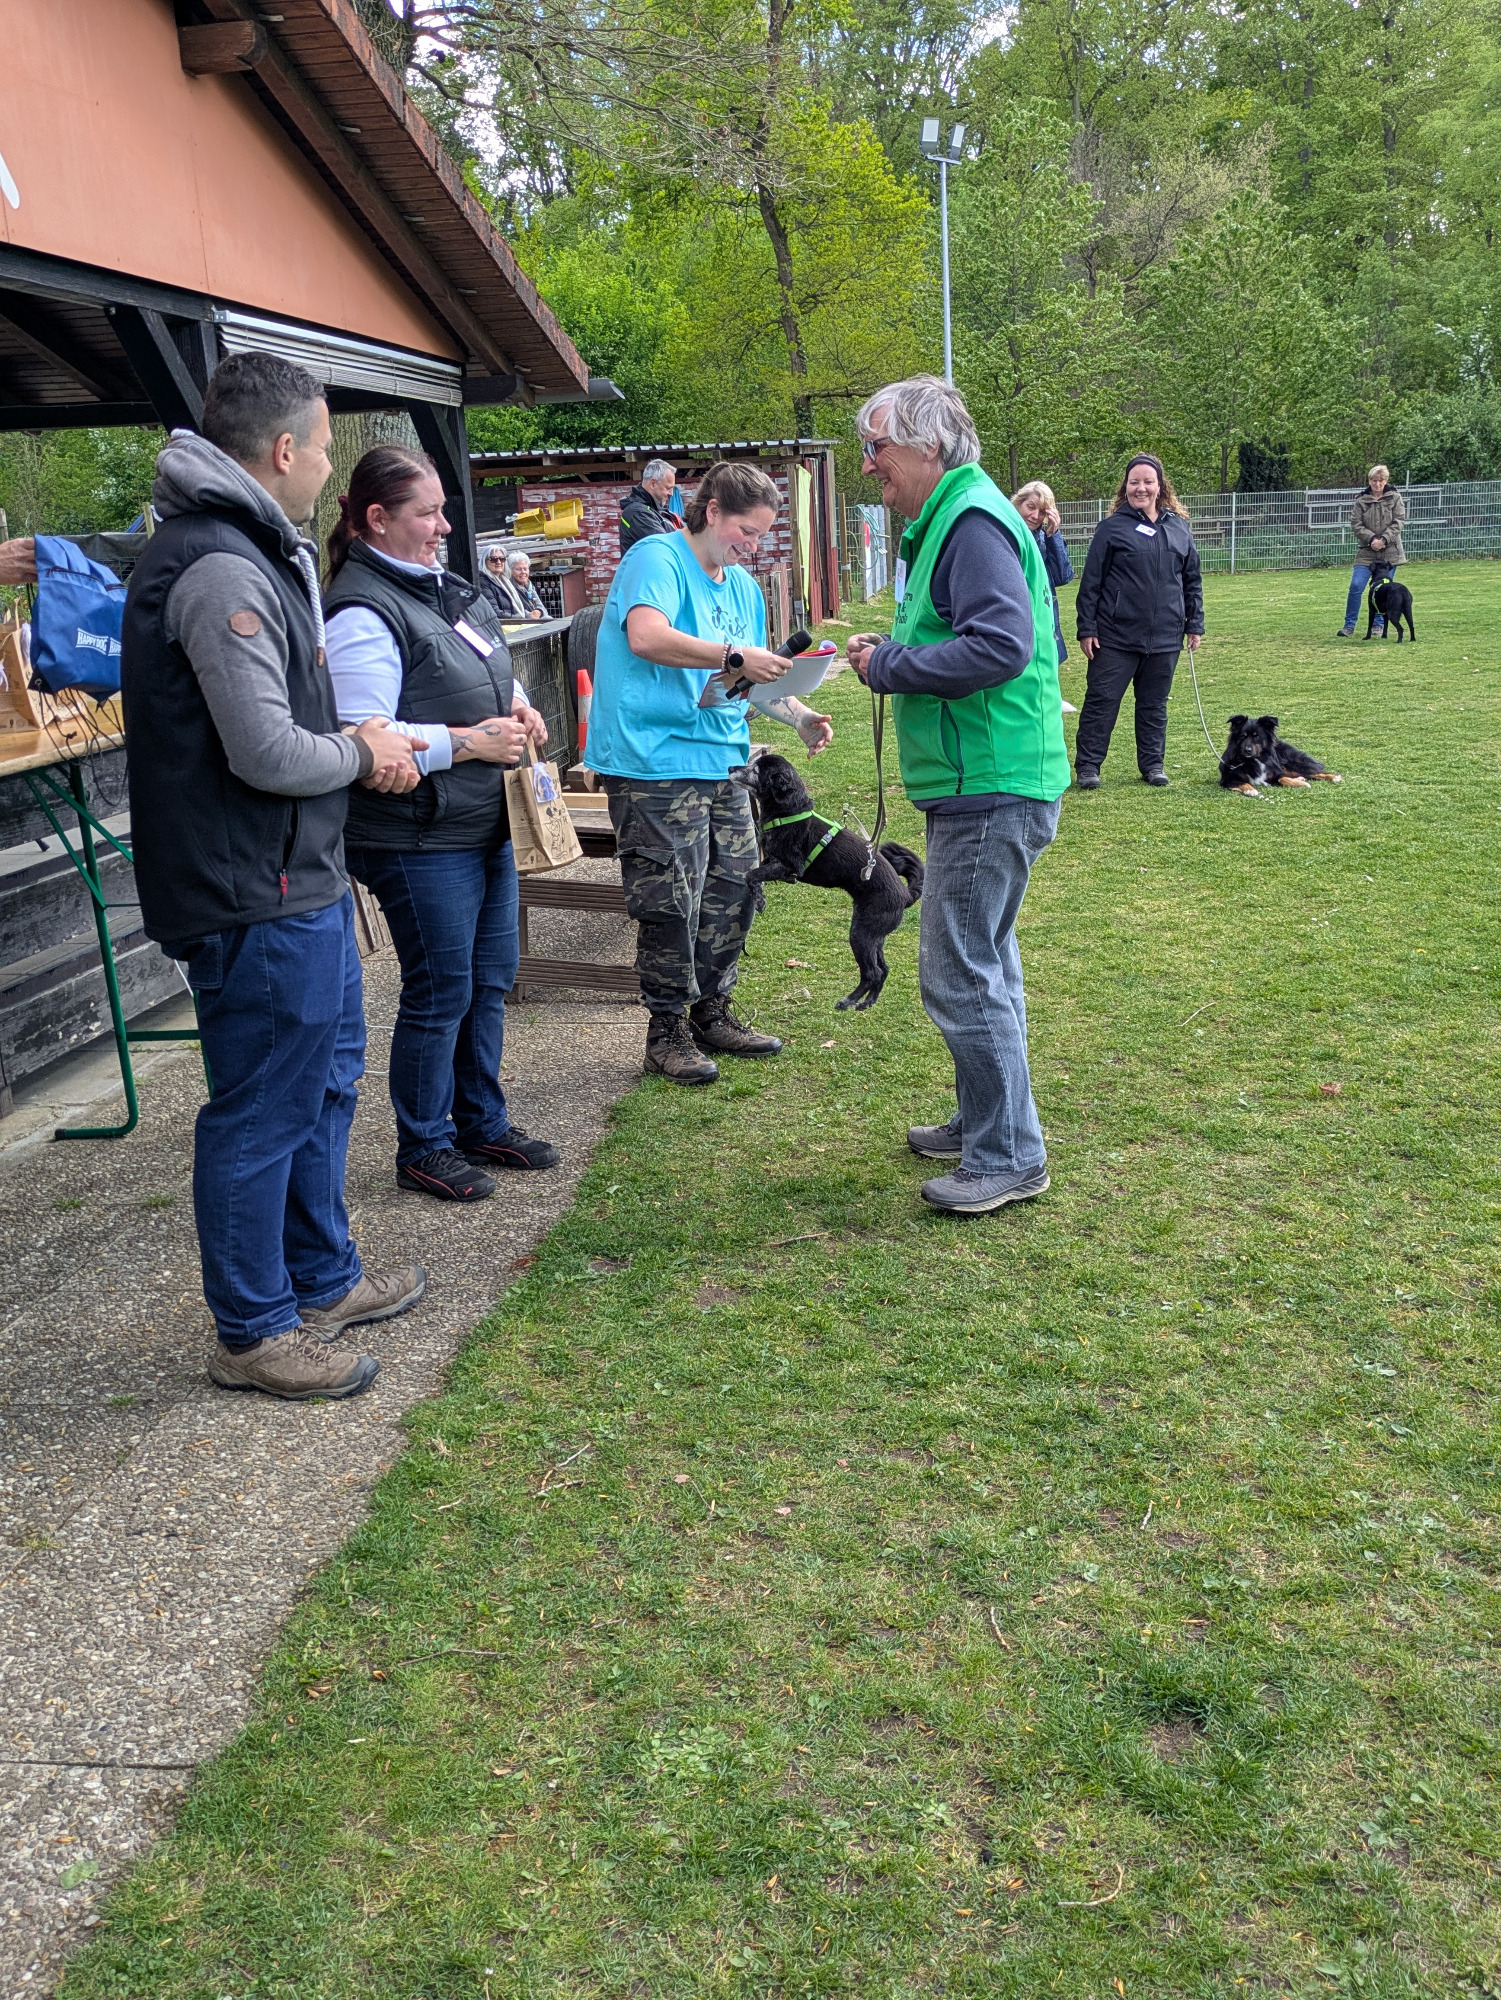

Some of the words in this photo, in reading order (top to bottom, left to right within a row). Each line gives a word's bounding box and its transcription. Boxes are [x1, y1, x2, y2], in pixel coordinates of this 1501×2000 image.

[728, 616, 747, 640] is
[77, 631, 97, 647] HAPPY
[96, 638, 108, 652] DOG
